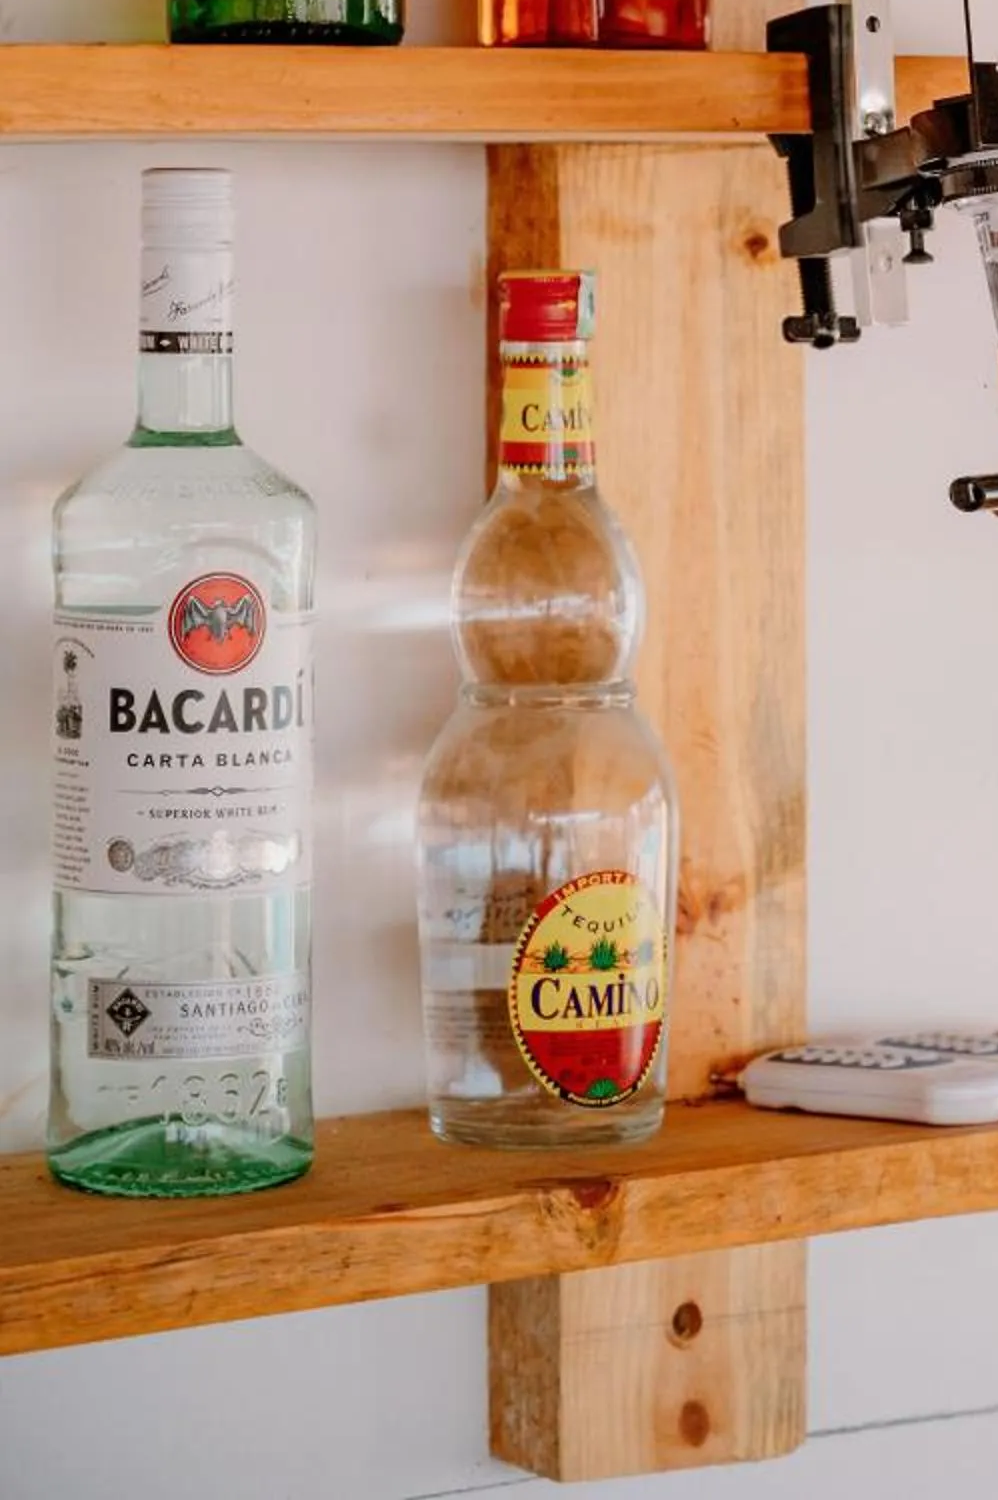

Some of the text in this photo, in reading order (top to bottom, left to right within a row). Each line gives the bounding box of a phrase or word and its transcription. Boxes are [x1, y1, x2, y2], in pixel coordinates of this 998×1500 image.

[126, 749, 292, 769] CARTA BLANCA
[179, 999, 270, 1019] SANTIAGO
